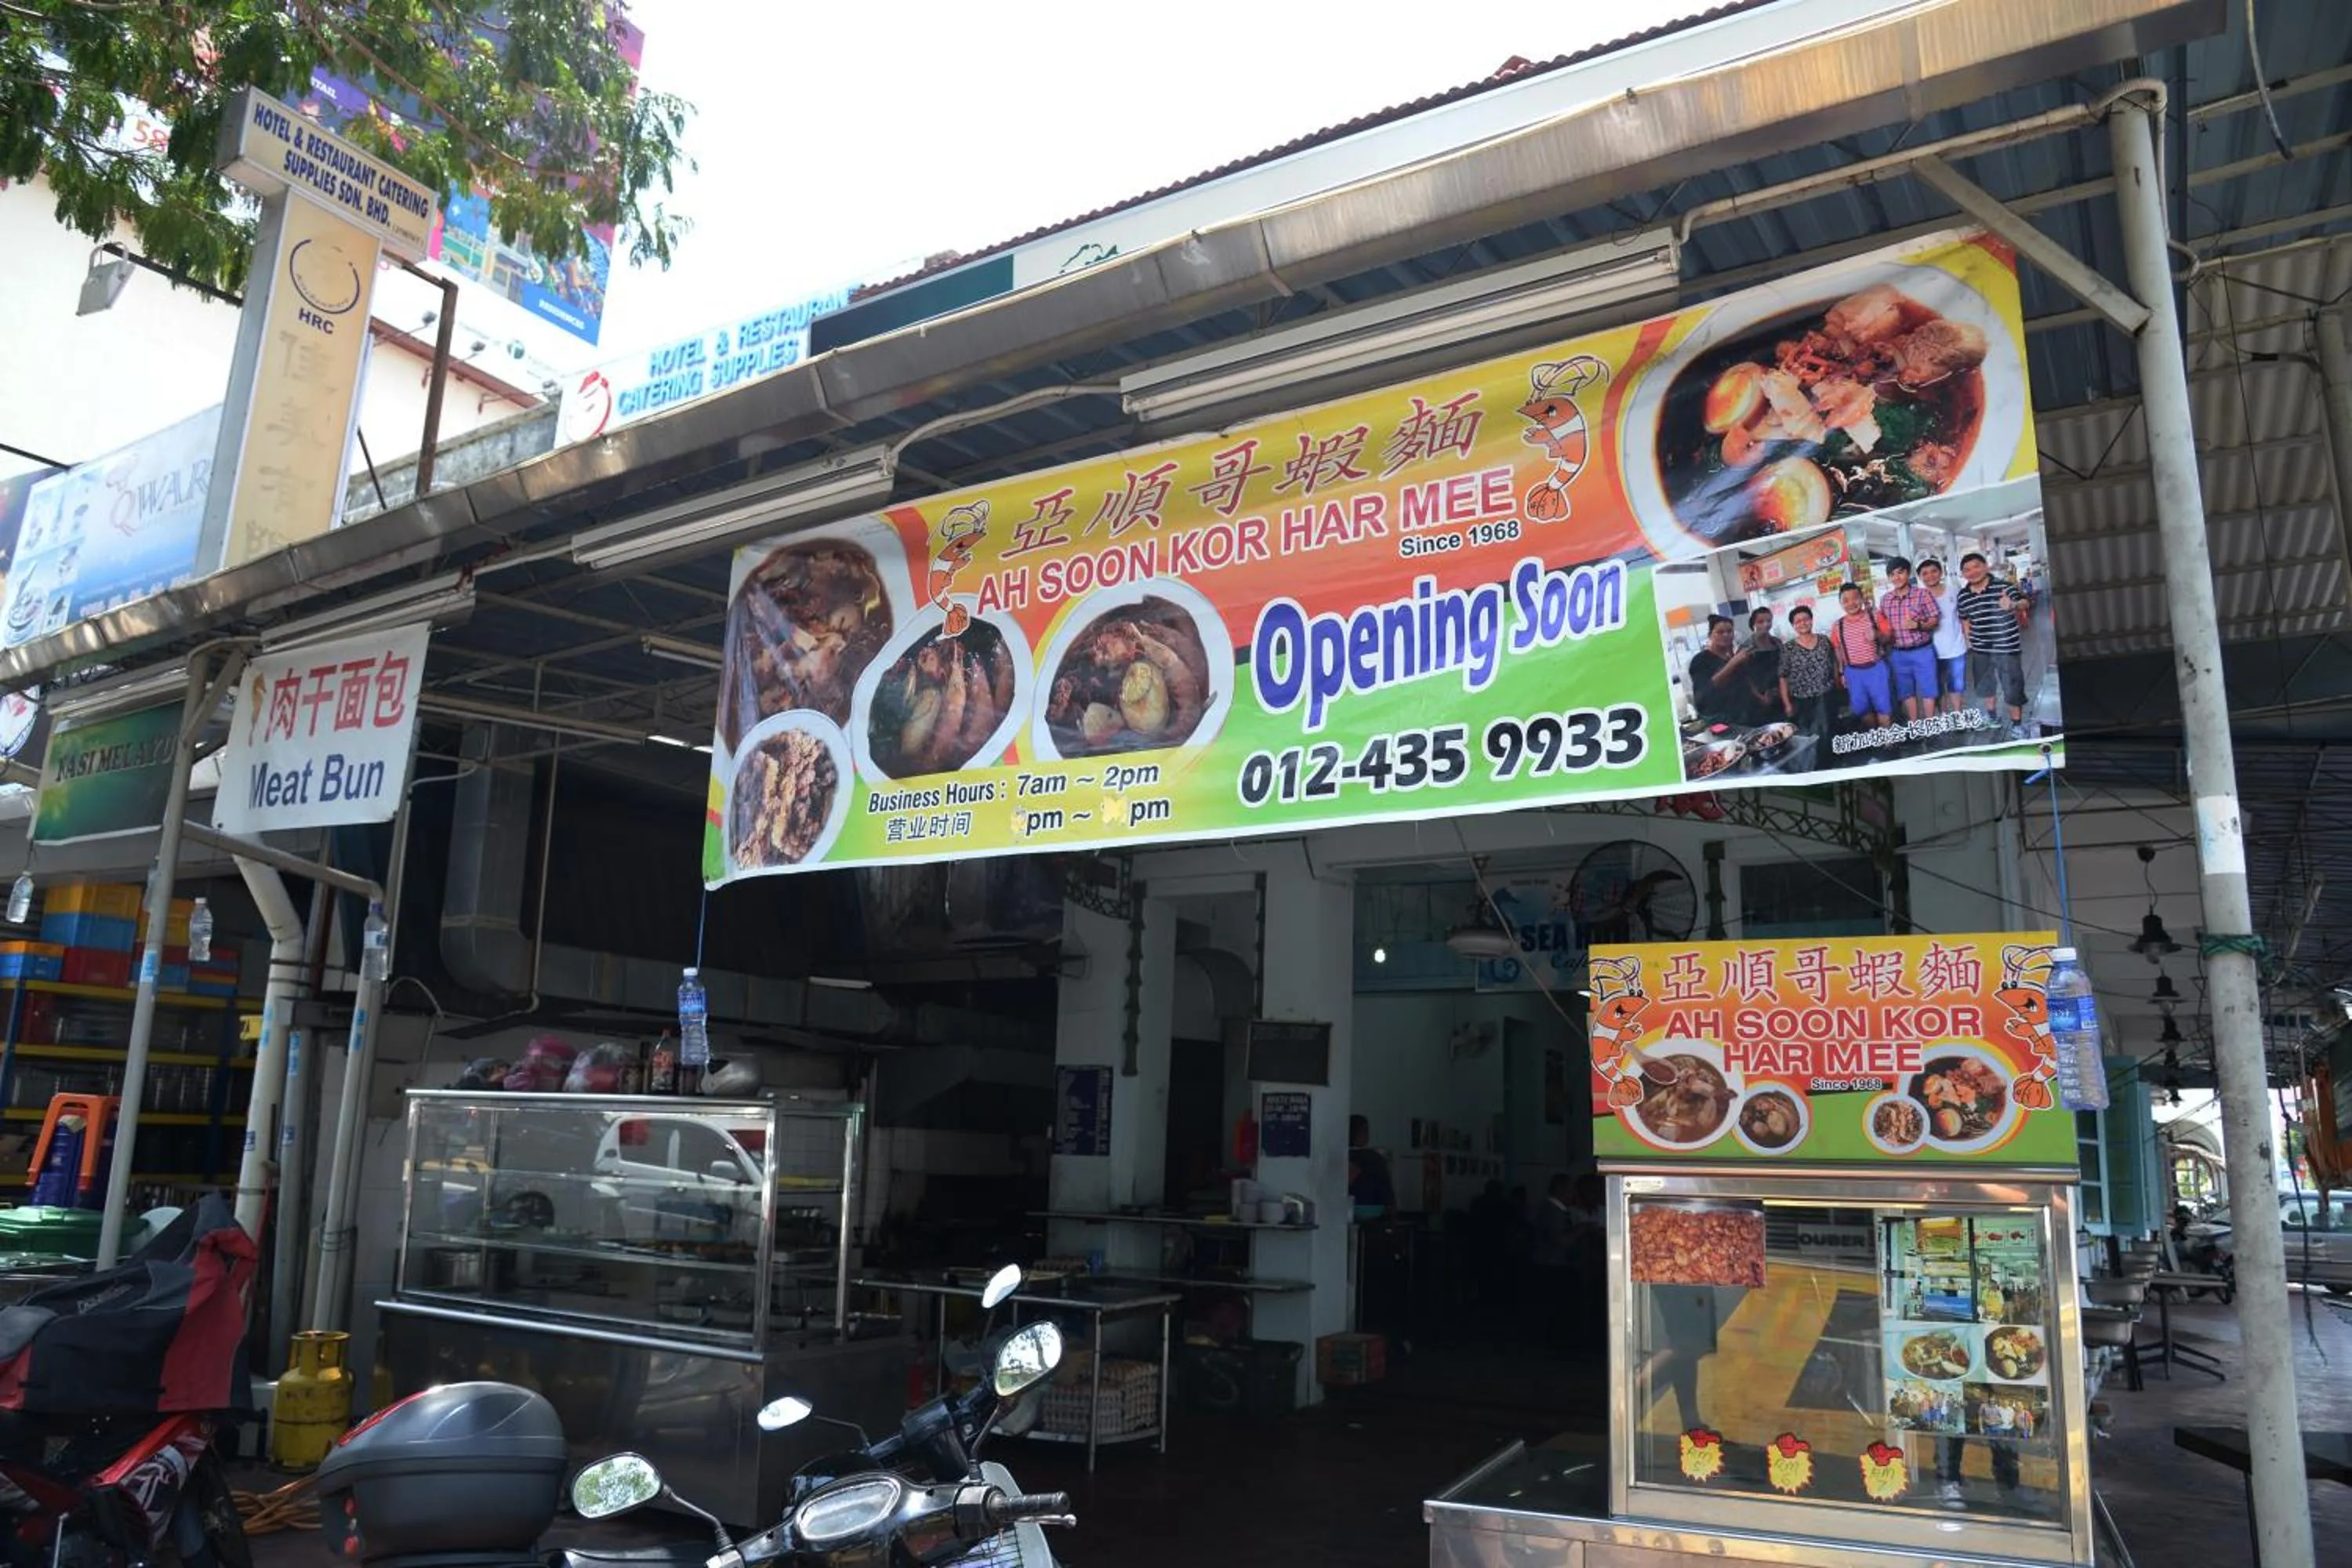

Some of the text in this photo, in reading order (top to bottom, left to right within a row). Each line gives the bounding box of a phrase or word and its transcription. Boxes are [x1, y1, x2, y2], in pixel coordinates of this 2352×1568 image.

[252, 103, 429, 219] HOTEL & RESTAURANT CATERING
[283, 149, 391, 227] SUPPLIES SDN. BHD.
[297, 307, 335, 335] HRC
[616, 339, 800, 416] CATERING SUPPLIES
[649, 338, 706, 378] HOTEL
[716, 328, 730, 357] &
[1000, 392, 1483, 560] 亞順哥蝦麵
[977, 468, 1514, 615] AH SOON KOR HAR MEE
[1401, 521, 1519, 557] Since 1968
[1254, 562, 1621, 728] Opening Soon
[264, 650, 409, 742] 肉干面包
[249, 753, 385, 810] Meat Bun
[1240, 707, 1645, 804] 012-435 9933
[868, 787, 940, 813] Business
[1017, 774, 1066, 797] 7am
[1103, 764, 1160, 789] 2pm
[886, 812, 972, 842] 营业时间
[1014, 808, 1063, 834] pm
[1519, 924, 1569, 953] SEA
[1660, 943, 1983, 1005] 亞順哥蝦麵
[1664, 1005, 1982, 1040] AH SOON KOR
[1722, 1040, 1925, 1075] HAR MEE
[1810, 1077, 1882, 1091] Since 1968
